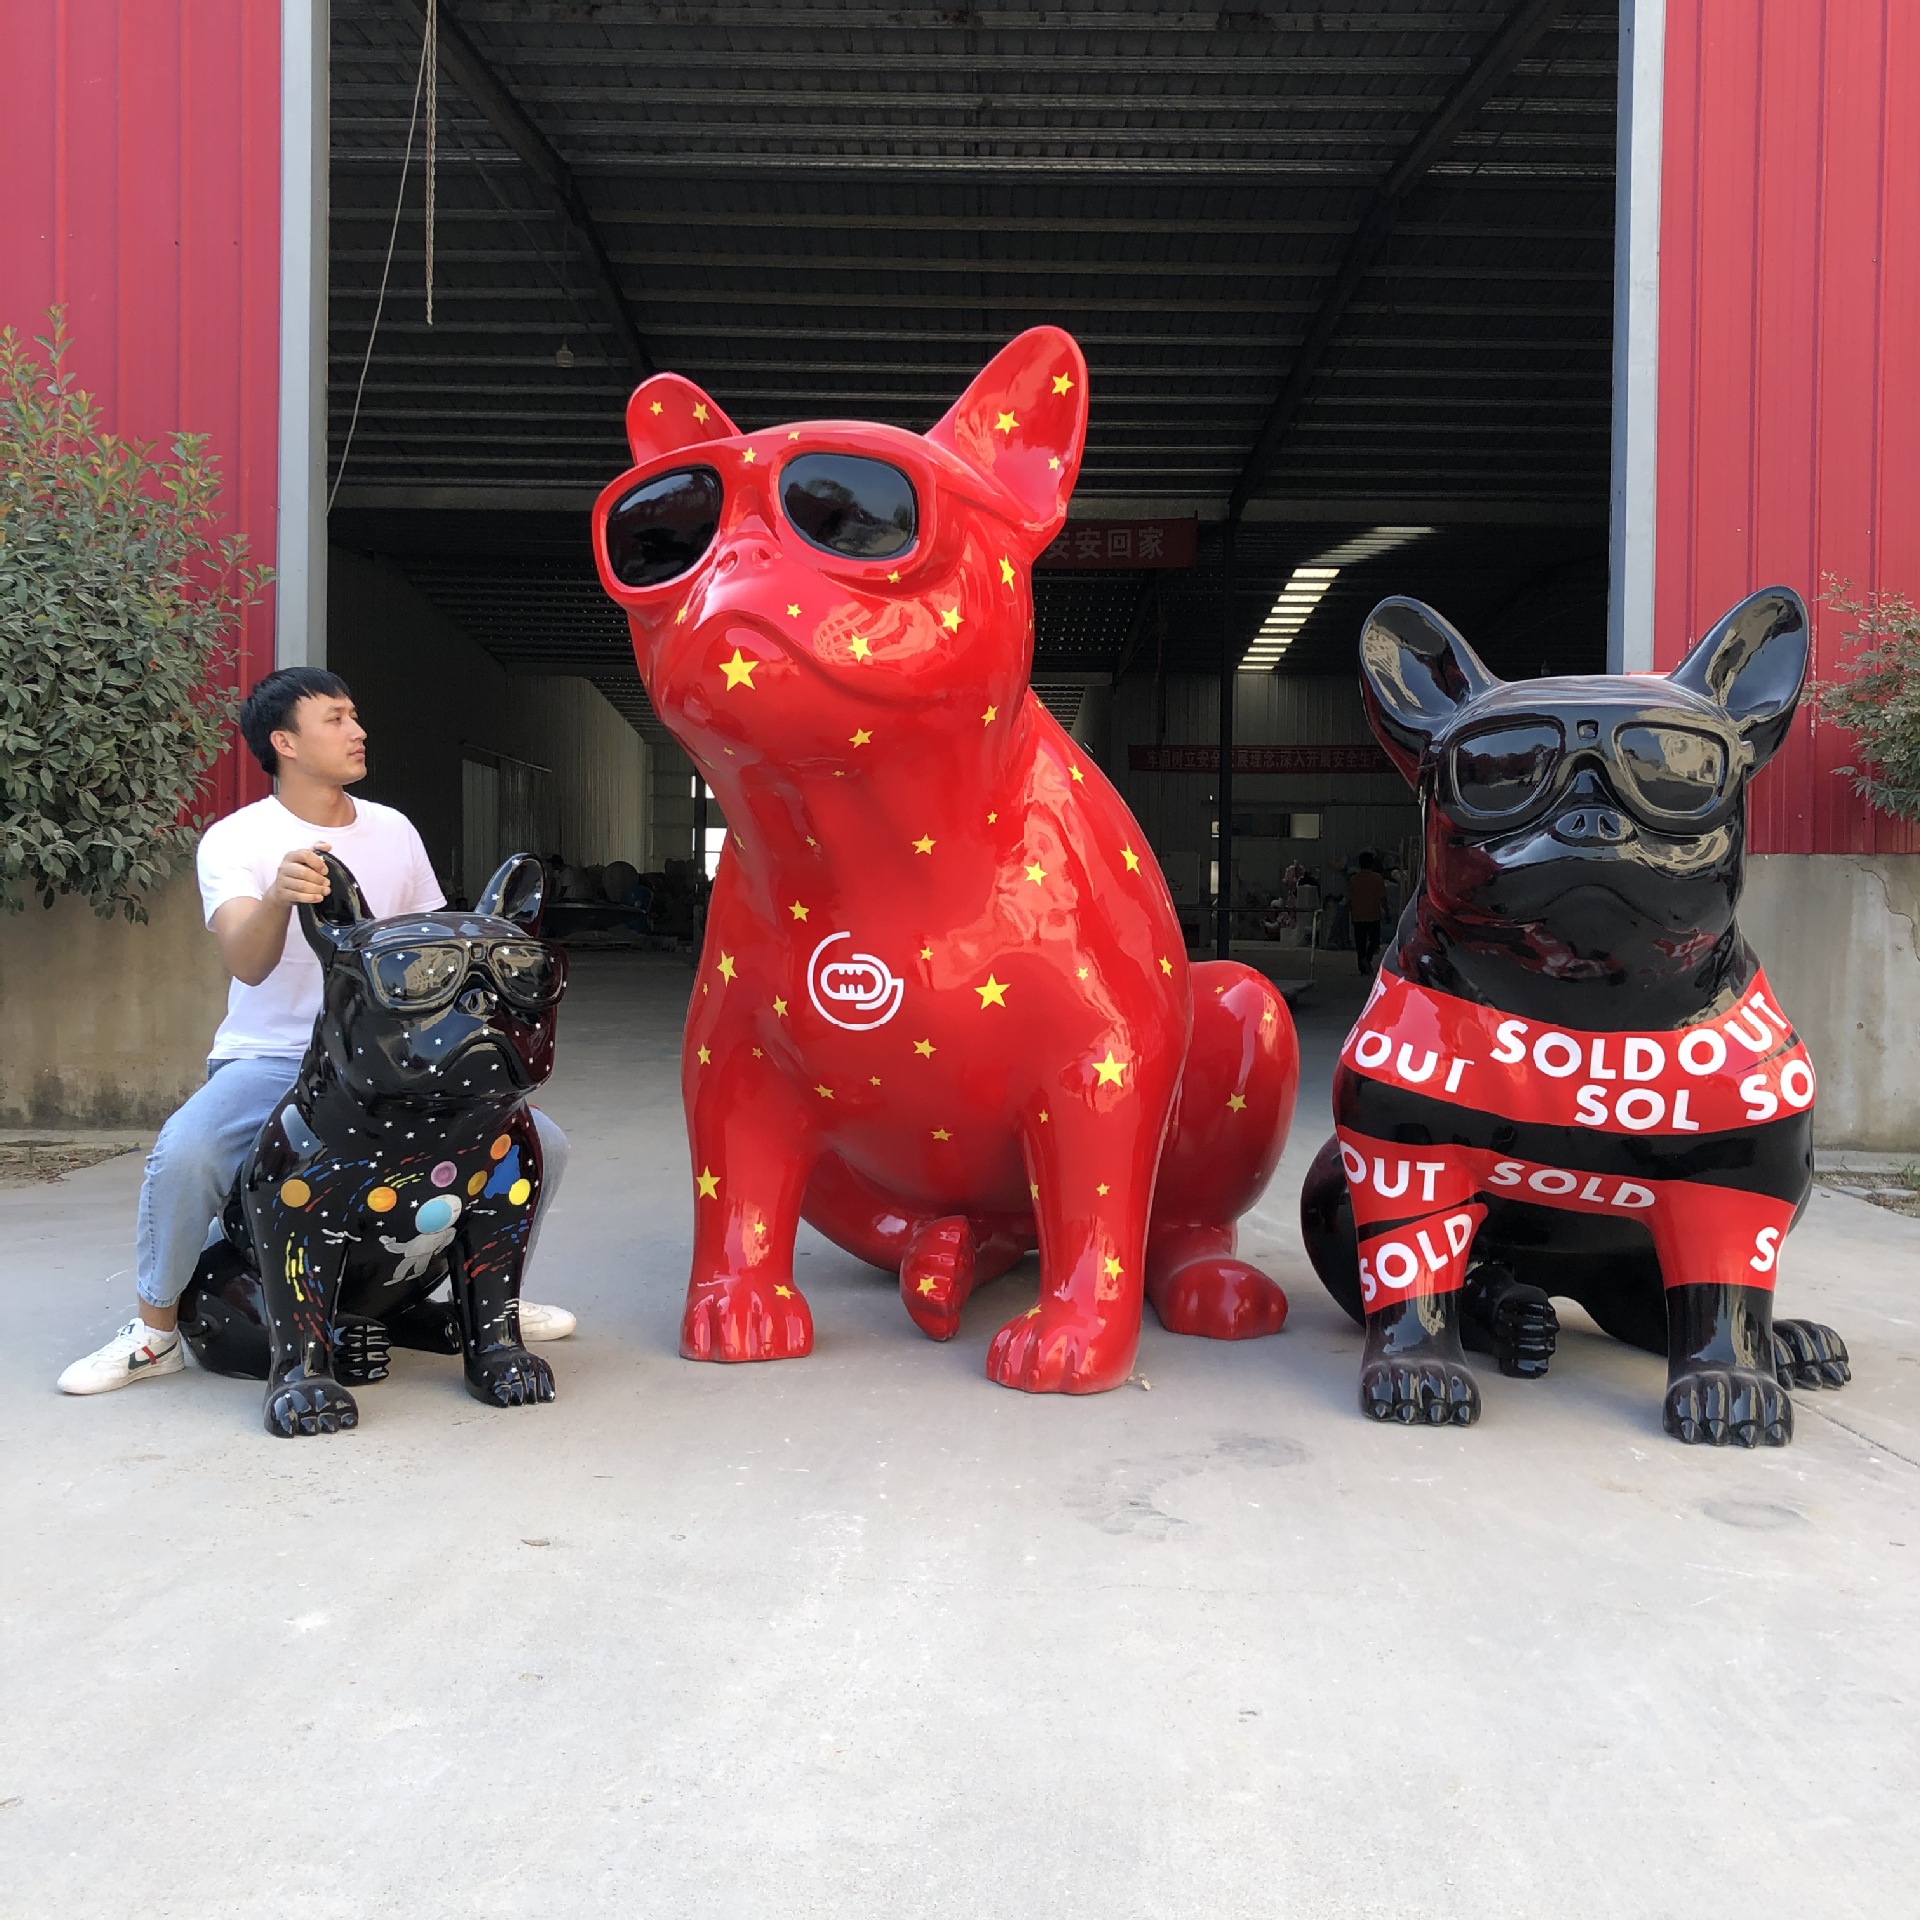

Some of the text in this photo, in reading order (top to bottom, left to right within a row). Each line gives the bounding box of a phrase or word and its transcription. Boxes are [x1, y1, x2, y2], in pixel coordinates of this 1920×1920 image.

[1045, 527, 1165, 561] 安安回家
[1354, 1029, 1475, 1094] OUT
[1489, 991, 1788, 1081] SOLD OUT
[1574, 1085, 1700, 1132] SOL
[1739, 1052, 1816, 1121] SO
[1339, 1140, 1446, 1202] OUT
[1488, 1161, 1656, 1208] SOLD
[1360, 1213, 1473, 1302] SOLD
[1749, 1226, 1783, 1274] S
